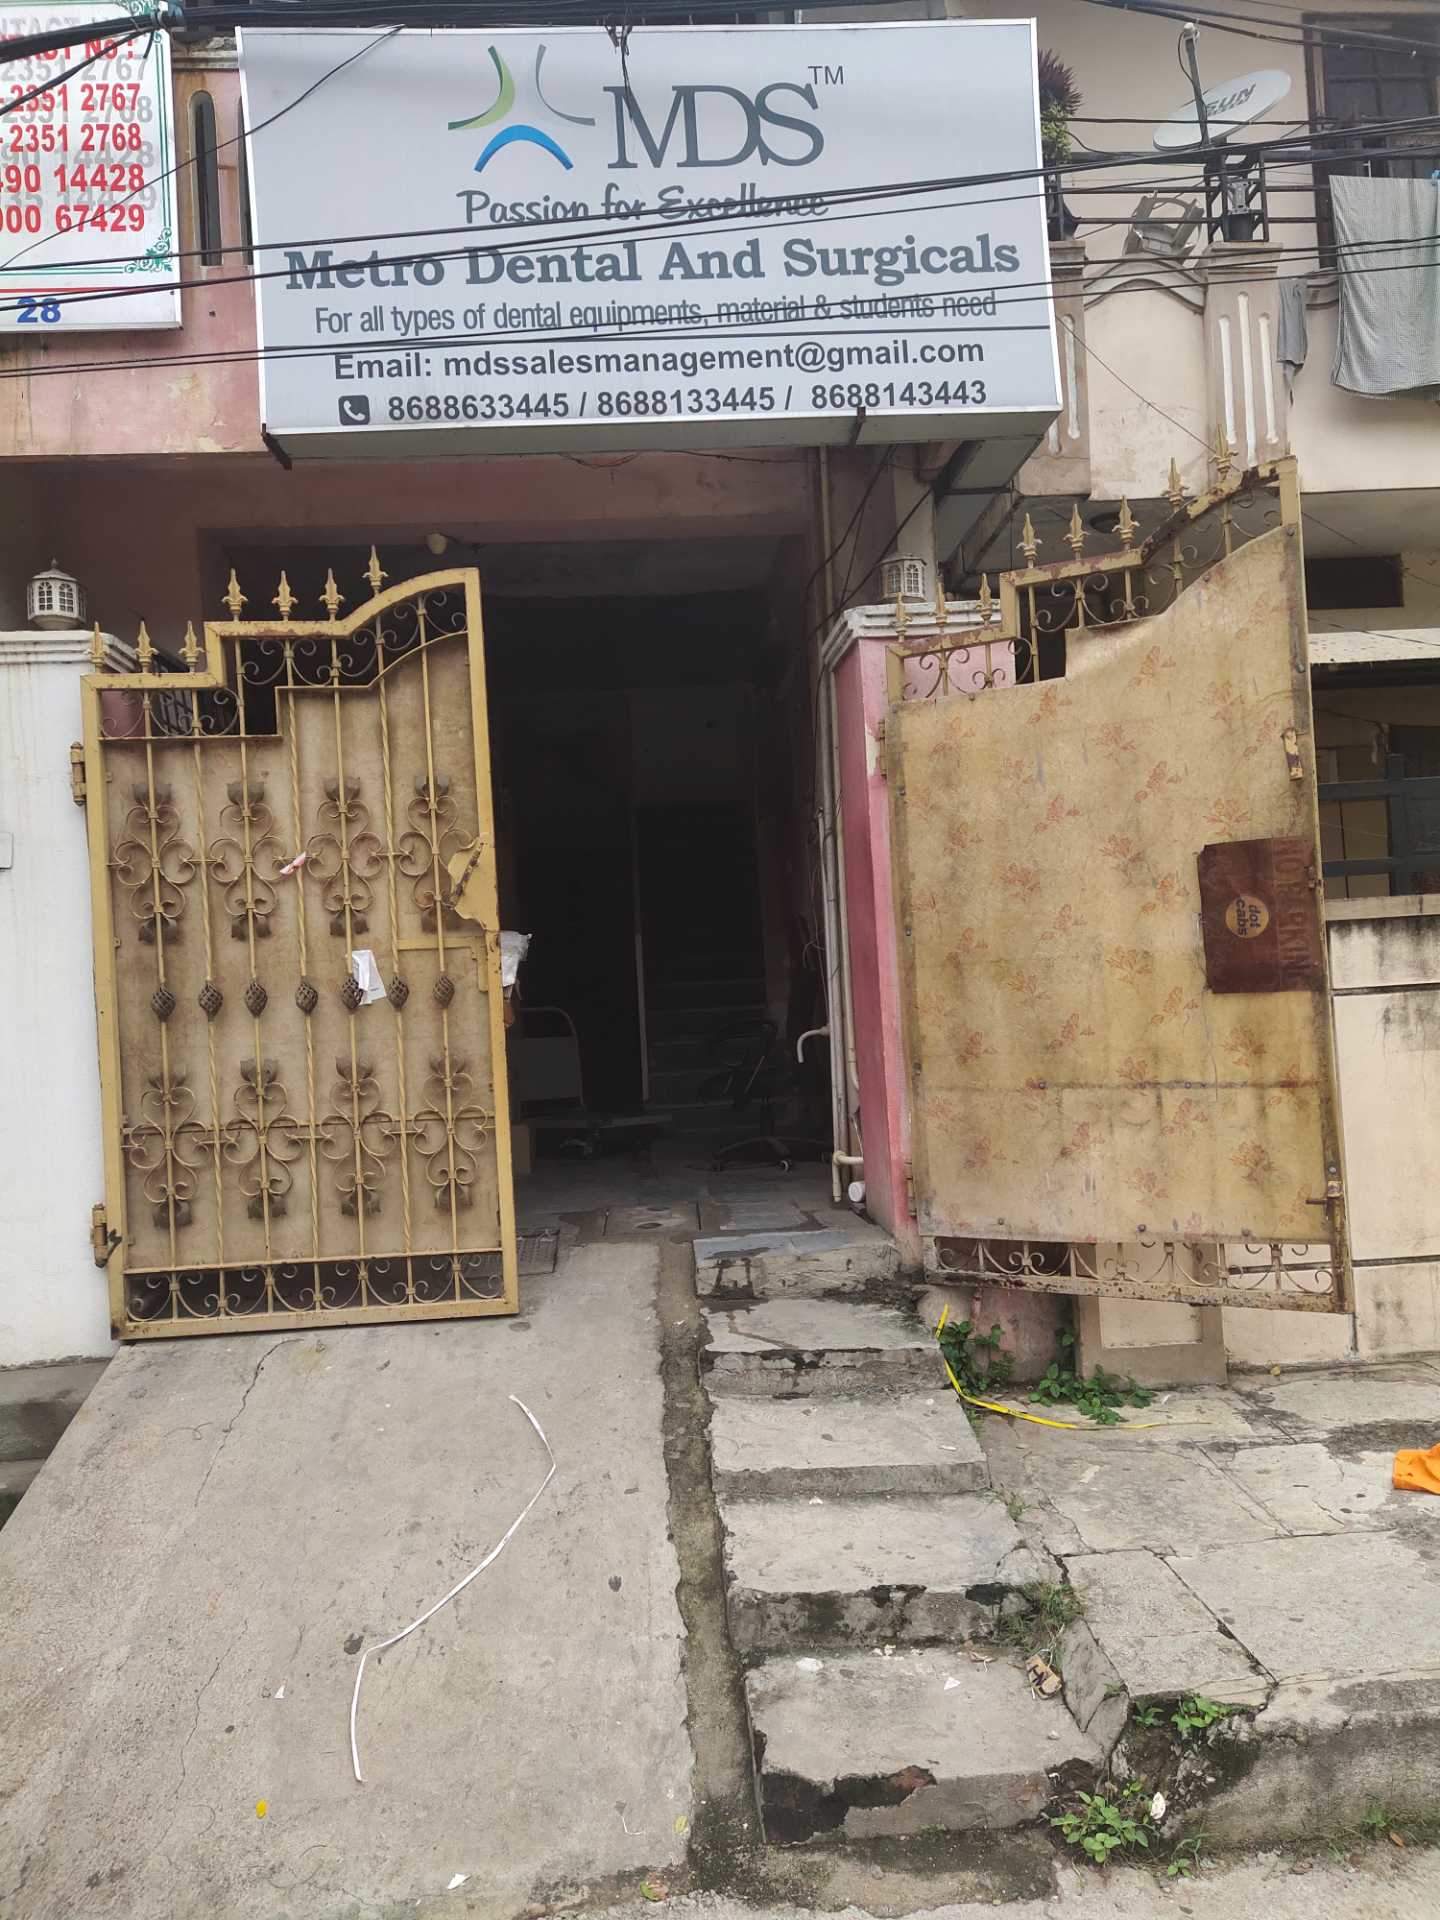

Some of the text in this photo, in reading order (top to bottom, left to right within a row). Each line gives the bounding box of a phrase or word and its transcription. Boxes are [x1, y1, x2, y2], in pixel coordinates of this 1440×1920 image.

[808, 66, 844, 85] TM
[80, 84, 140, 111] 2767
[80, 123, 142, 152] 2768
[603, 82, 824, 169] MDS
[54, 163, 145, 192] 14428
[55, 203, 145, 233] 67429
[456, 189, 588, 224] Passion
[601, 182, 646, 221] for
[284, 233, 1020, 290] Metro Dental And Surgicals
[17, 296, 61, 323] 28
[316, 290, 997, 336] For all types of dental equipments, material & students need
[334, 339, 985, 380] Email: mdssalesmanagement@gmail.com
[388, 392, 570, 421] 8688633445
[597, 385, 775, 418] 8688133445
[811, 380, 987, 410] 8688143443
[1236, 898, 1248, 937] cabs
[1249, 904, 1261, 928] dot
